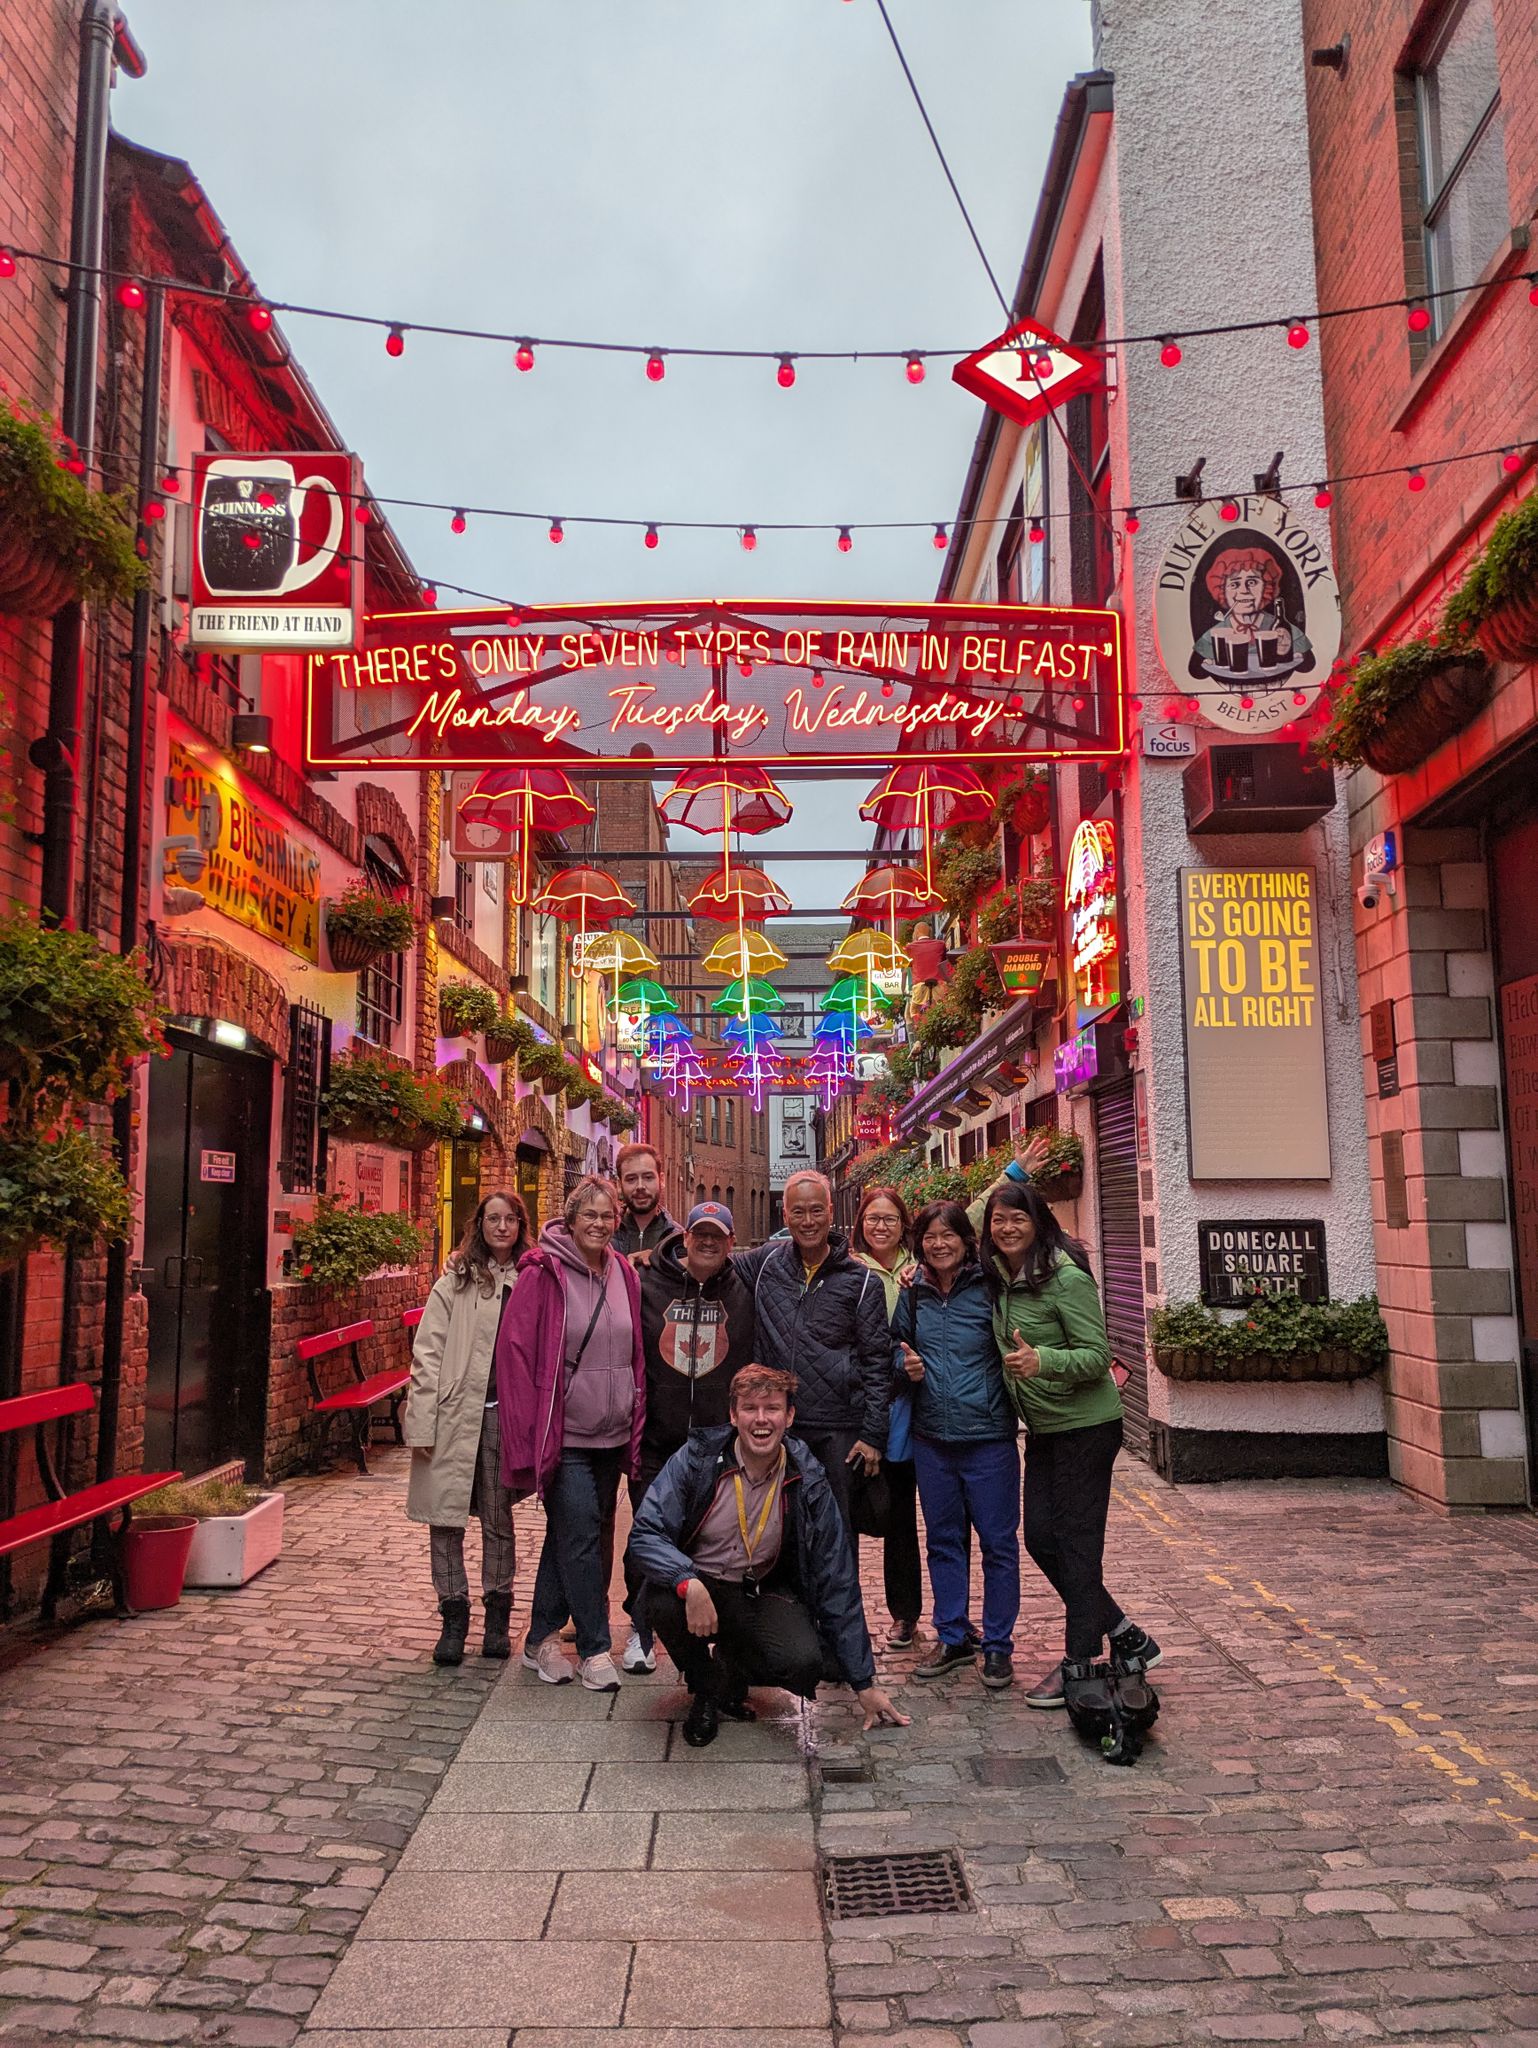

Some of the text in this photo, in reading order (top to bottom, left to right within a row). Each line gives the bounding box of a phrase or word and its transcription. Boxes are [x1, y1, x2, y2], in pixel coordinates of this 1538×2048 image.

[208, 502, 287, 517] GUINNESS
[1159, 515, 1215, 591] DUKE
[1275, 512, 1332, 589] YORK
[198, 614, 342, 632] THE FRIEND AT HAND
[471, 634, 545, 675] ONLY
[561, 631, 659, 669] SEVEN
[674, 630, 771, 668] TYPES
[784, 630, 821, 665] OF
[837, 630, 908, 668] RAIN
[922, 634, 950, 671] IN
[1216, 699, 1288, 723] BELFAST
[1150, 738, 1191, 752] focus
[1367, 852, 1383, 873] focus
[208, 850, 297, 938] WHISKEY
[1188, 873, 1310, 898] EVERYTHING
[1188, 900, 1312, 937] IS GOING
[1003, 963, 1042, 973] DIAMOND
[1007, 954, 1040, 963] DOUBLE
[1190, 938, 1314, 994] TO BE
[1194, 996, 1315, 1028] ALL RIGHT
[1209, 1231, 1316, 1250] DONEGALL
[1224, 1254, 1304, 1273] SQUARE
